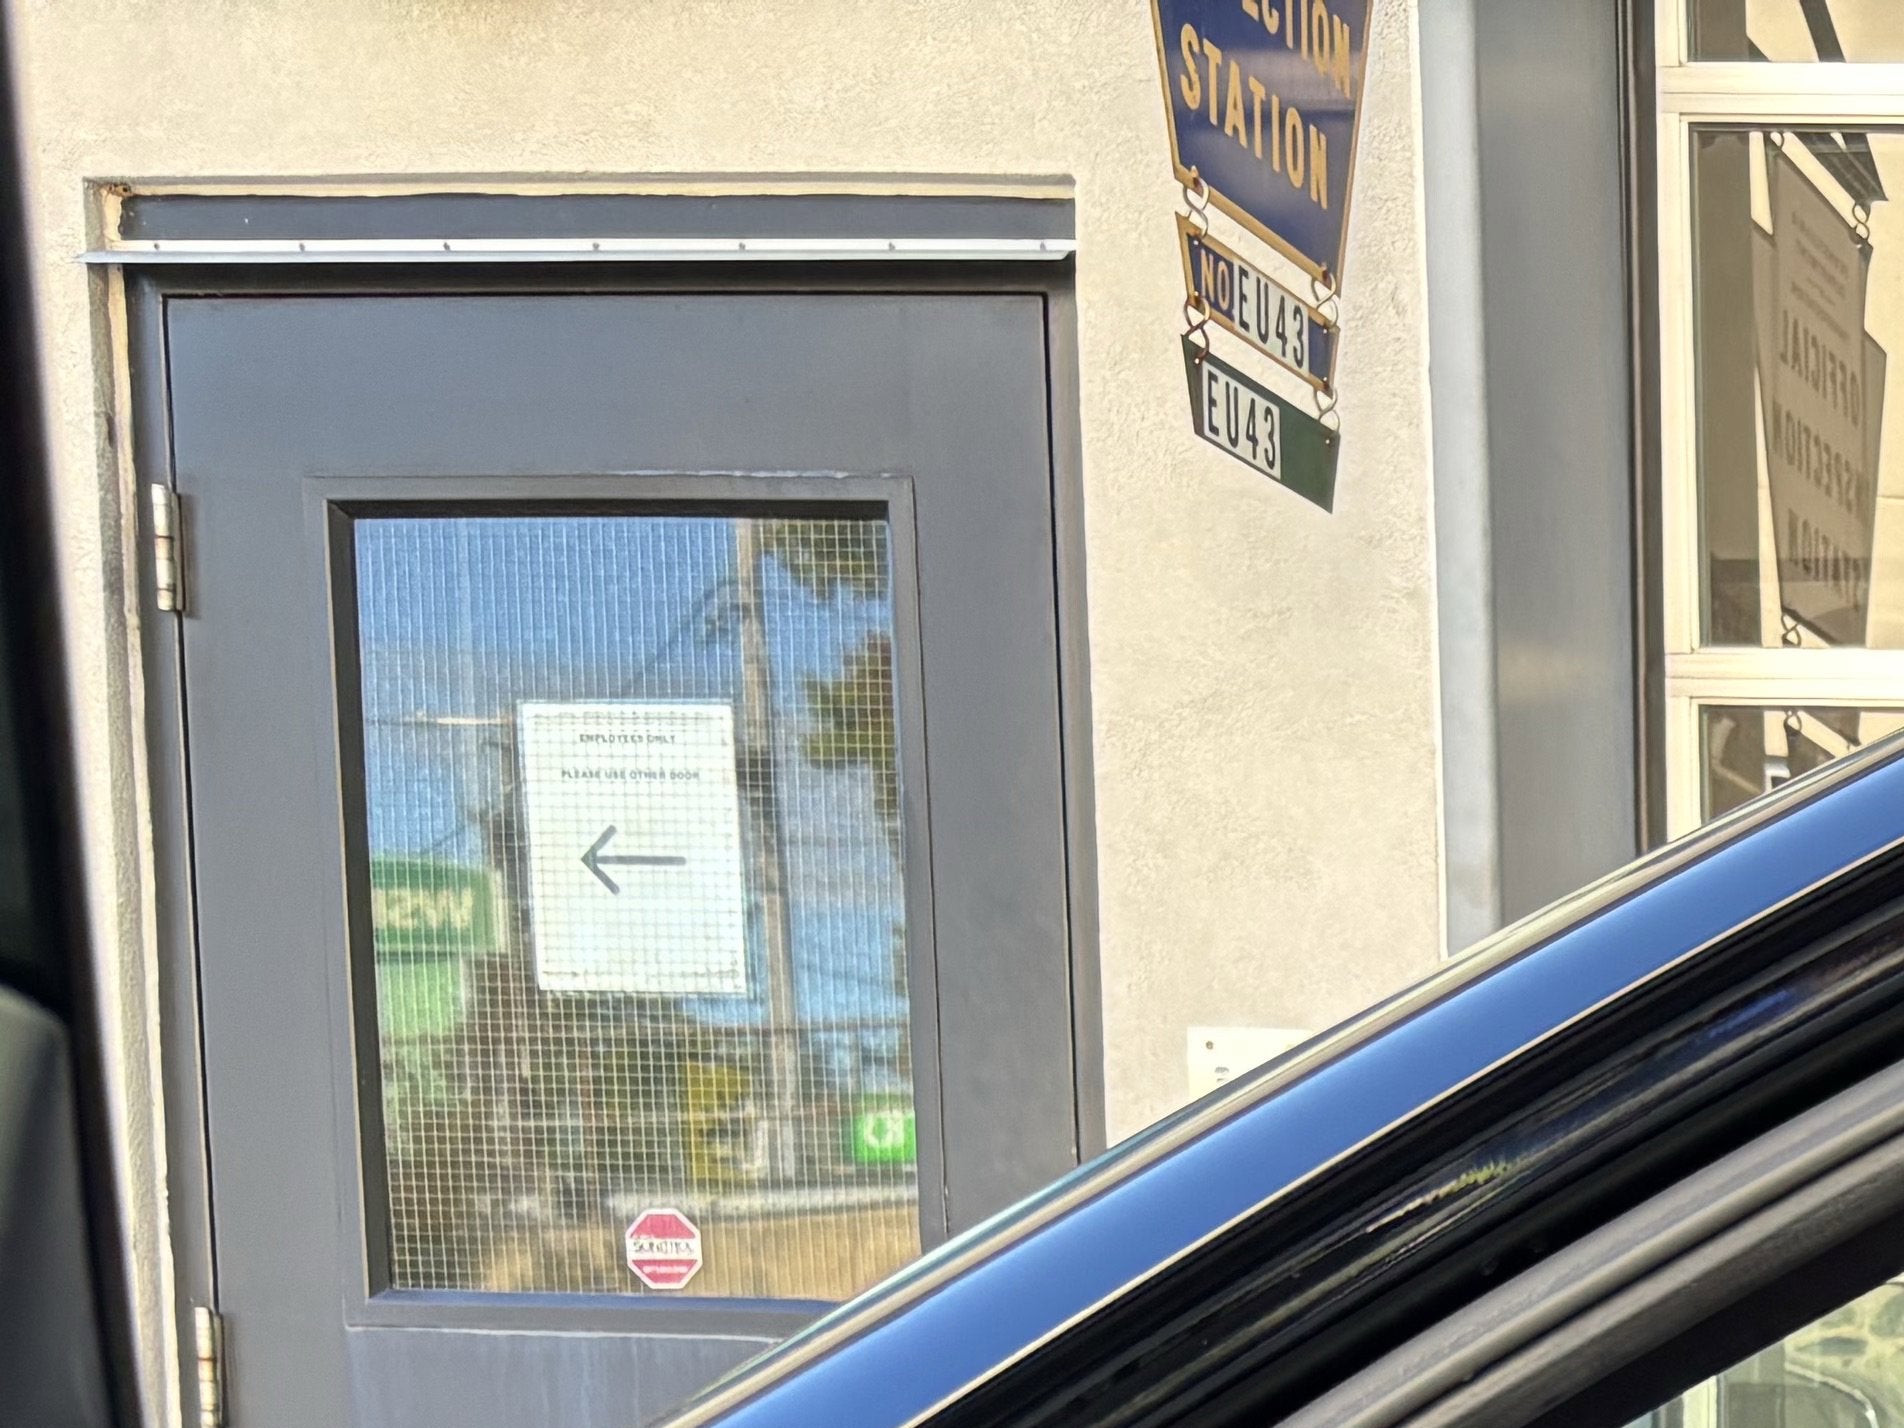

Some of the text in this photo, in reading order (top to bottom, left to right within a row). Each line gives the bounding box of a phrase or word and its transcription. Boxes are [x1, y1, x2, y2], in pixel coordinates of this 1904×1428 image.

[1180, 23, 1328, 209] STATION
[1200, 247, 1305, 369] NO EU43
[1207, 369, 1276, 471] EU43
[561, 769, 700, 780] PLEASE USE OTHER DOOR
[579, 733, 677, 744] EMPLOYEES ONLY
